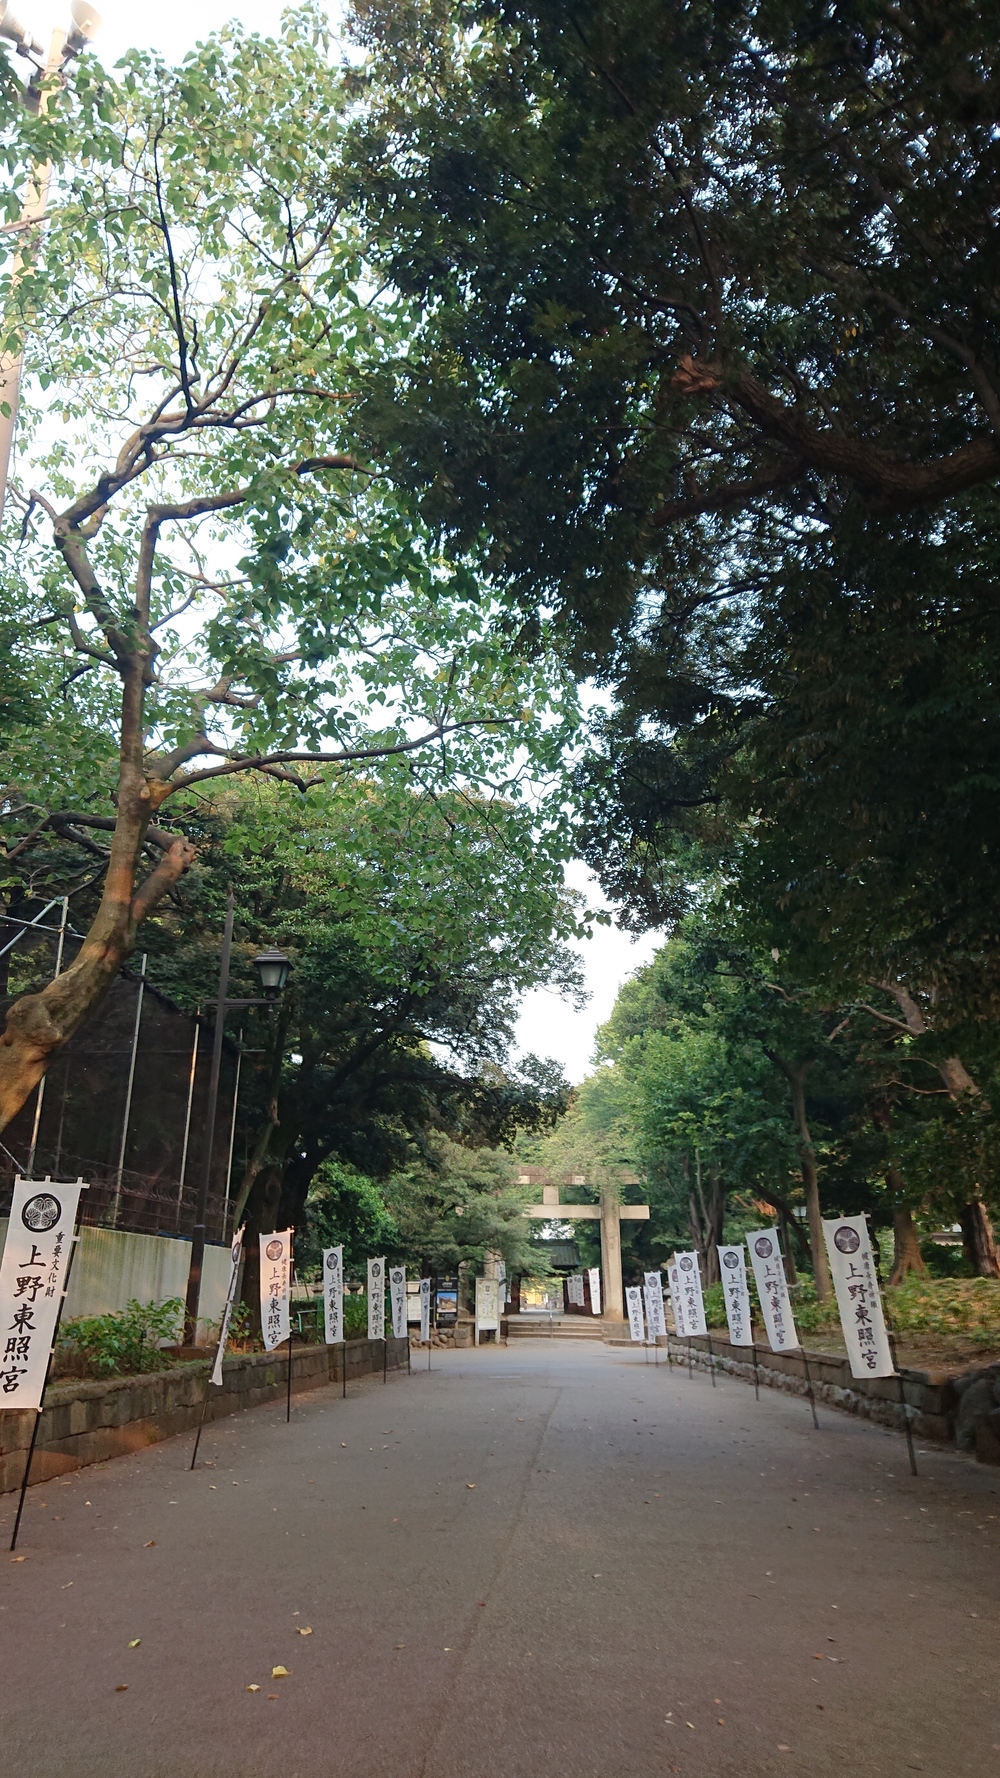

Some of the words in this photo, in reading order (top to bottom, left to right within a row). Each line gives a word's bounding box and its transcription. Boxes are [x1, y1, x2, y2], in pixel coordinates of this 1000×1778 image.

[44, 1231, 66, 1298] 重要文化財
[0, 1244, 47, 1394] 上野東照宮
[267, 1266, 282, 1345] 上野東照宮
[328, 1275, 339, 1338] 上野東照宮
[371, 1281, 381, 1336] 上野東照宮
[684, 1275, 699, 1330] 上野東照宮
[728, 1273, 743, 1339] 上野東照宮
[763, 1264, 786, 1344] 上野東照宮
[845, 1262, 878, 1370] 上野東照宮
